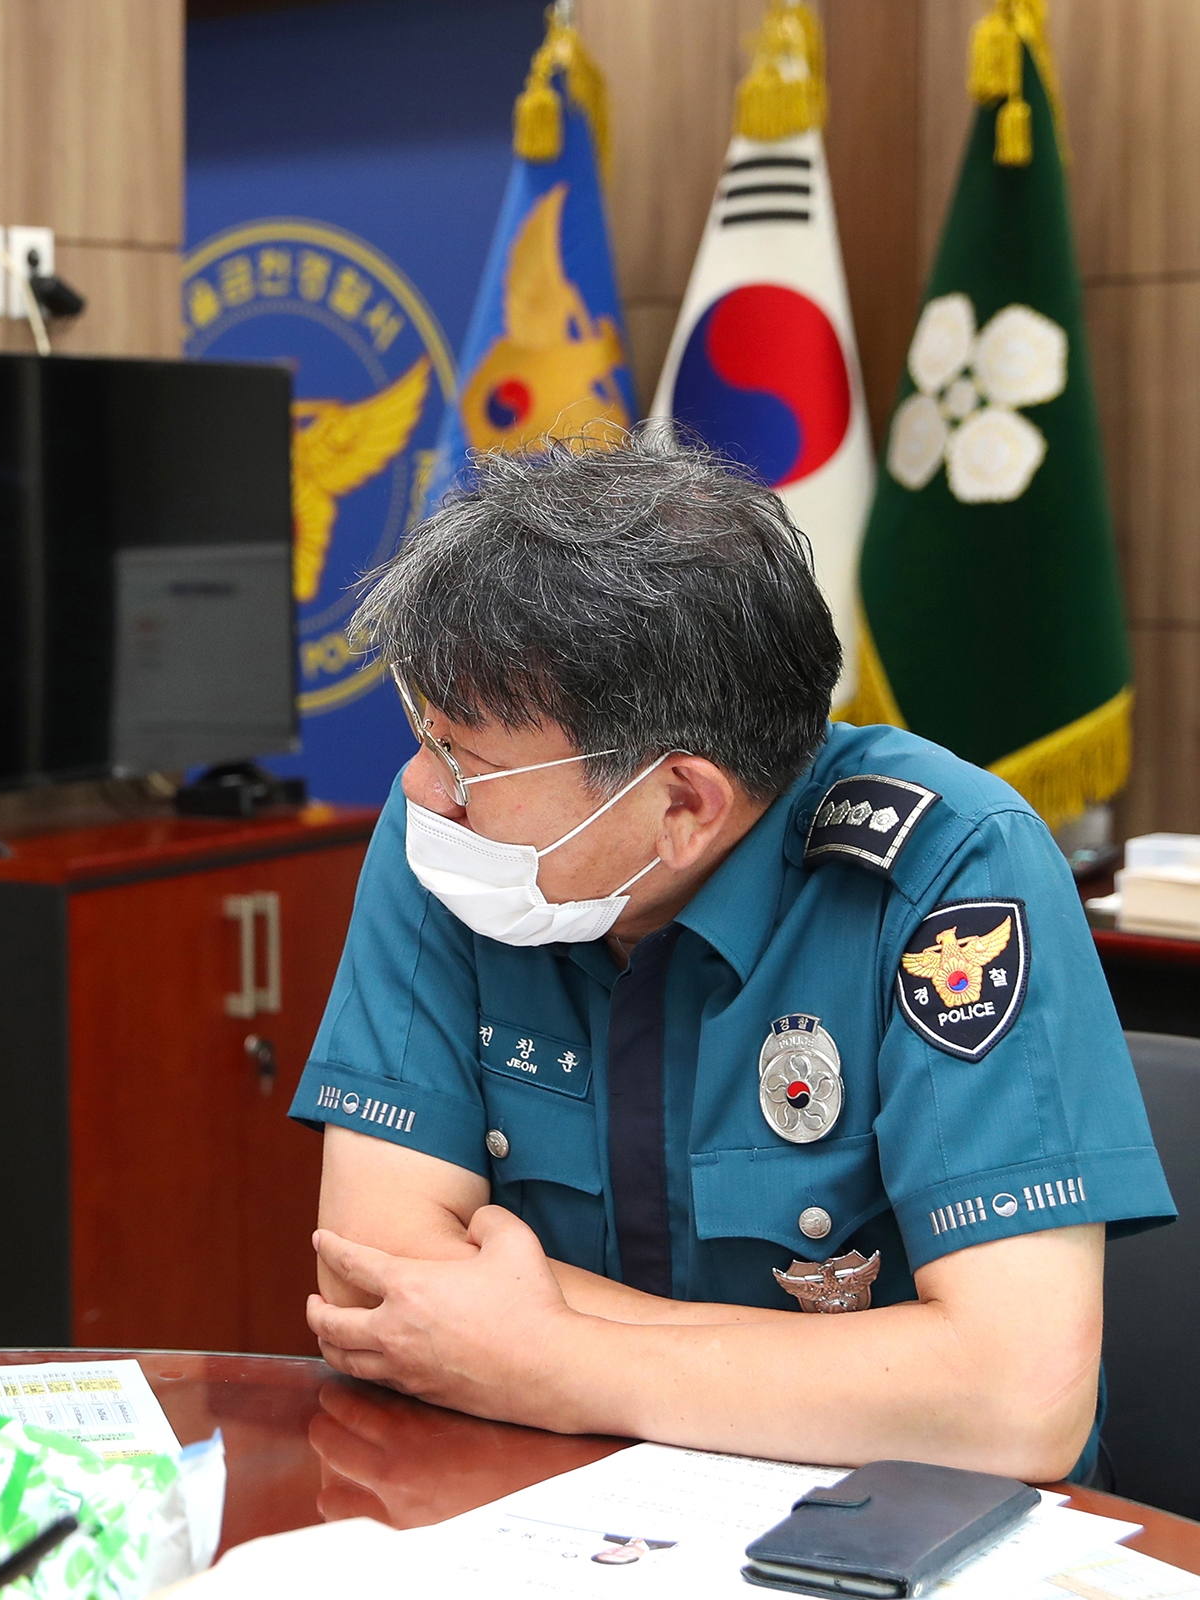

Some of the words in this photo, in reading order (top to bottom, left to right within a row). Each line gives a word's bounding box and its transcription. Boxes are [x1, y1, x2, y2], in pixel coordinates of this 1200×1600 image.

[182, 248, 405, 354] 울금천경찰서
[937, 1001, 996, 1027] POLICE
[506, 1057, 538, 1075] JEON
